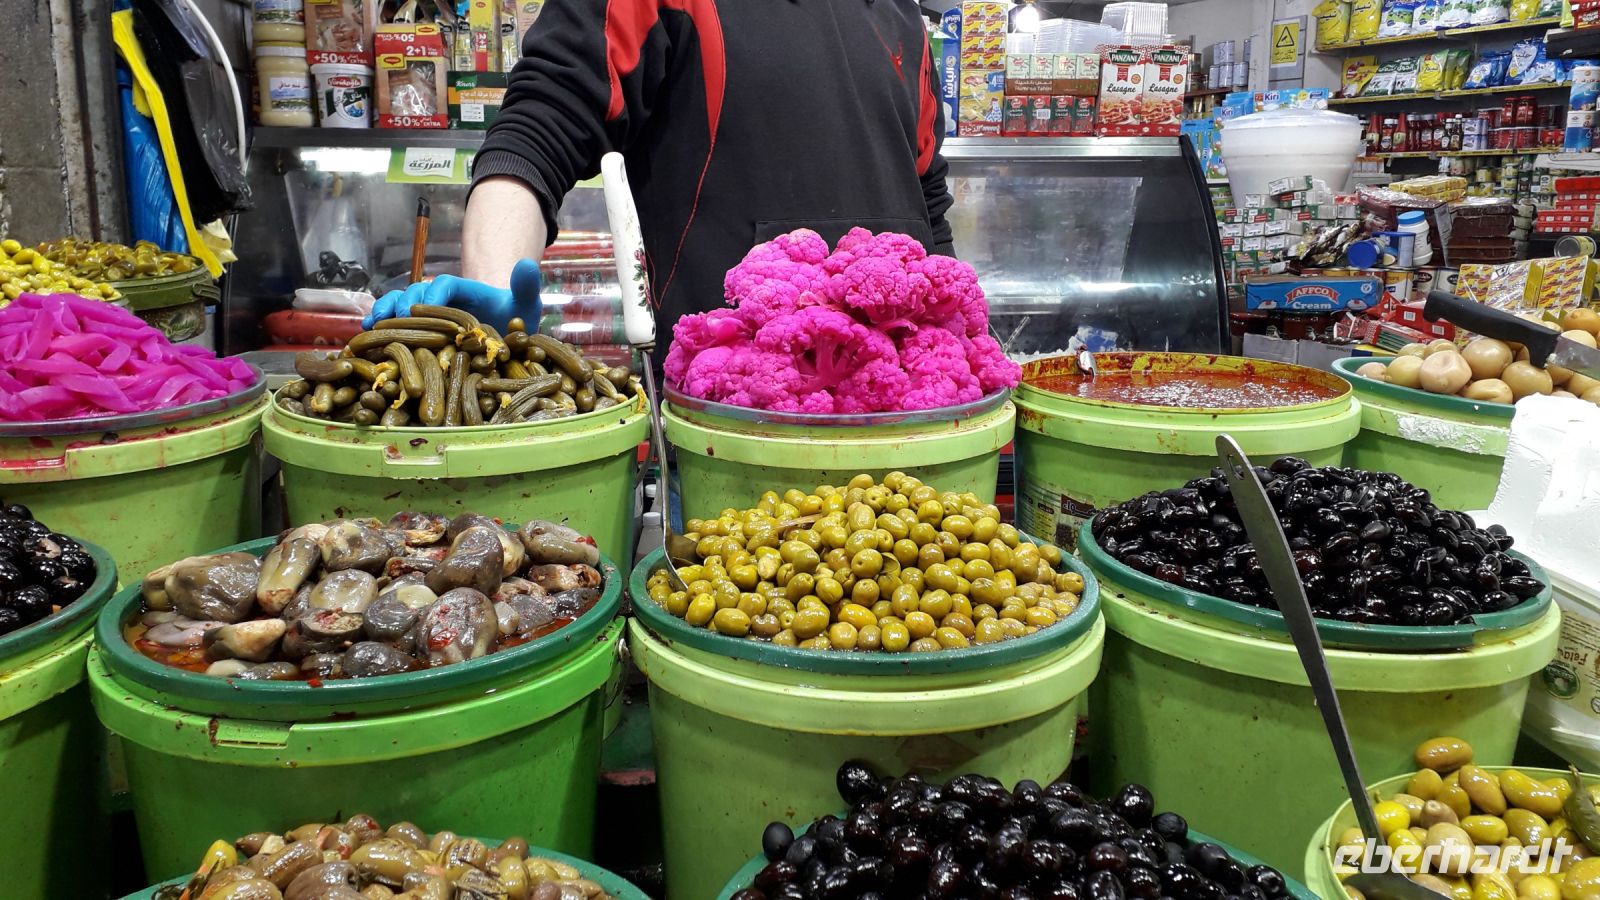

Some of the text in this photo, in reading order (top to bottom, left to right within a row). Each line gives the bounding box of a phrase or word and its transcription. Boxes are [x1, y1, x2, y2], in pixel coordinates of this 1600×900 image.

[406, 45, 426, 56] 2+1
[1111, 54, 1138, 62] PANZANI
[1154, 54, 1180, 62] PANZANI
[942, 67, 954, 98] الباشا
[990, 76, 997, 86] 4
[1107, 83, 1136, 95] Lasagne
[1149, 83, 1178, 95] Lasagne
[1264, 92, 1280, 101] Kiri
[388, 117, 420, 127] +50%
[409, 159, 452, 170] المزرعة
[1296, 287, 1329, 295] AFFCO
[1292, 301, 1332, 309] Cream
